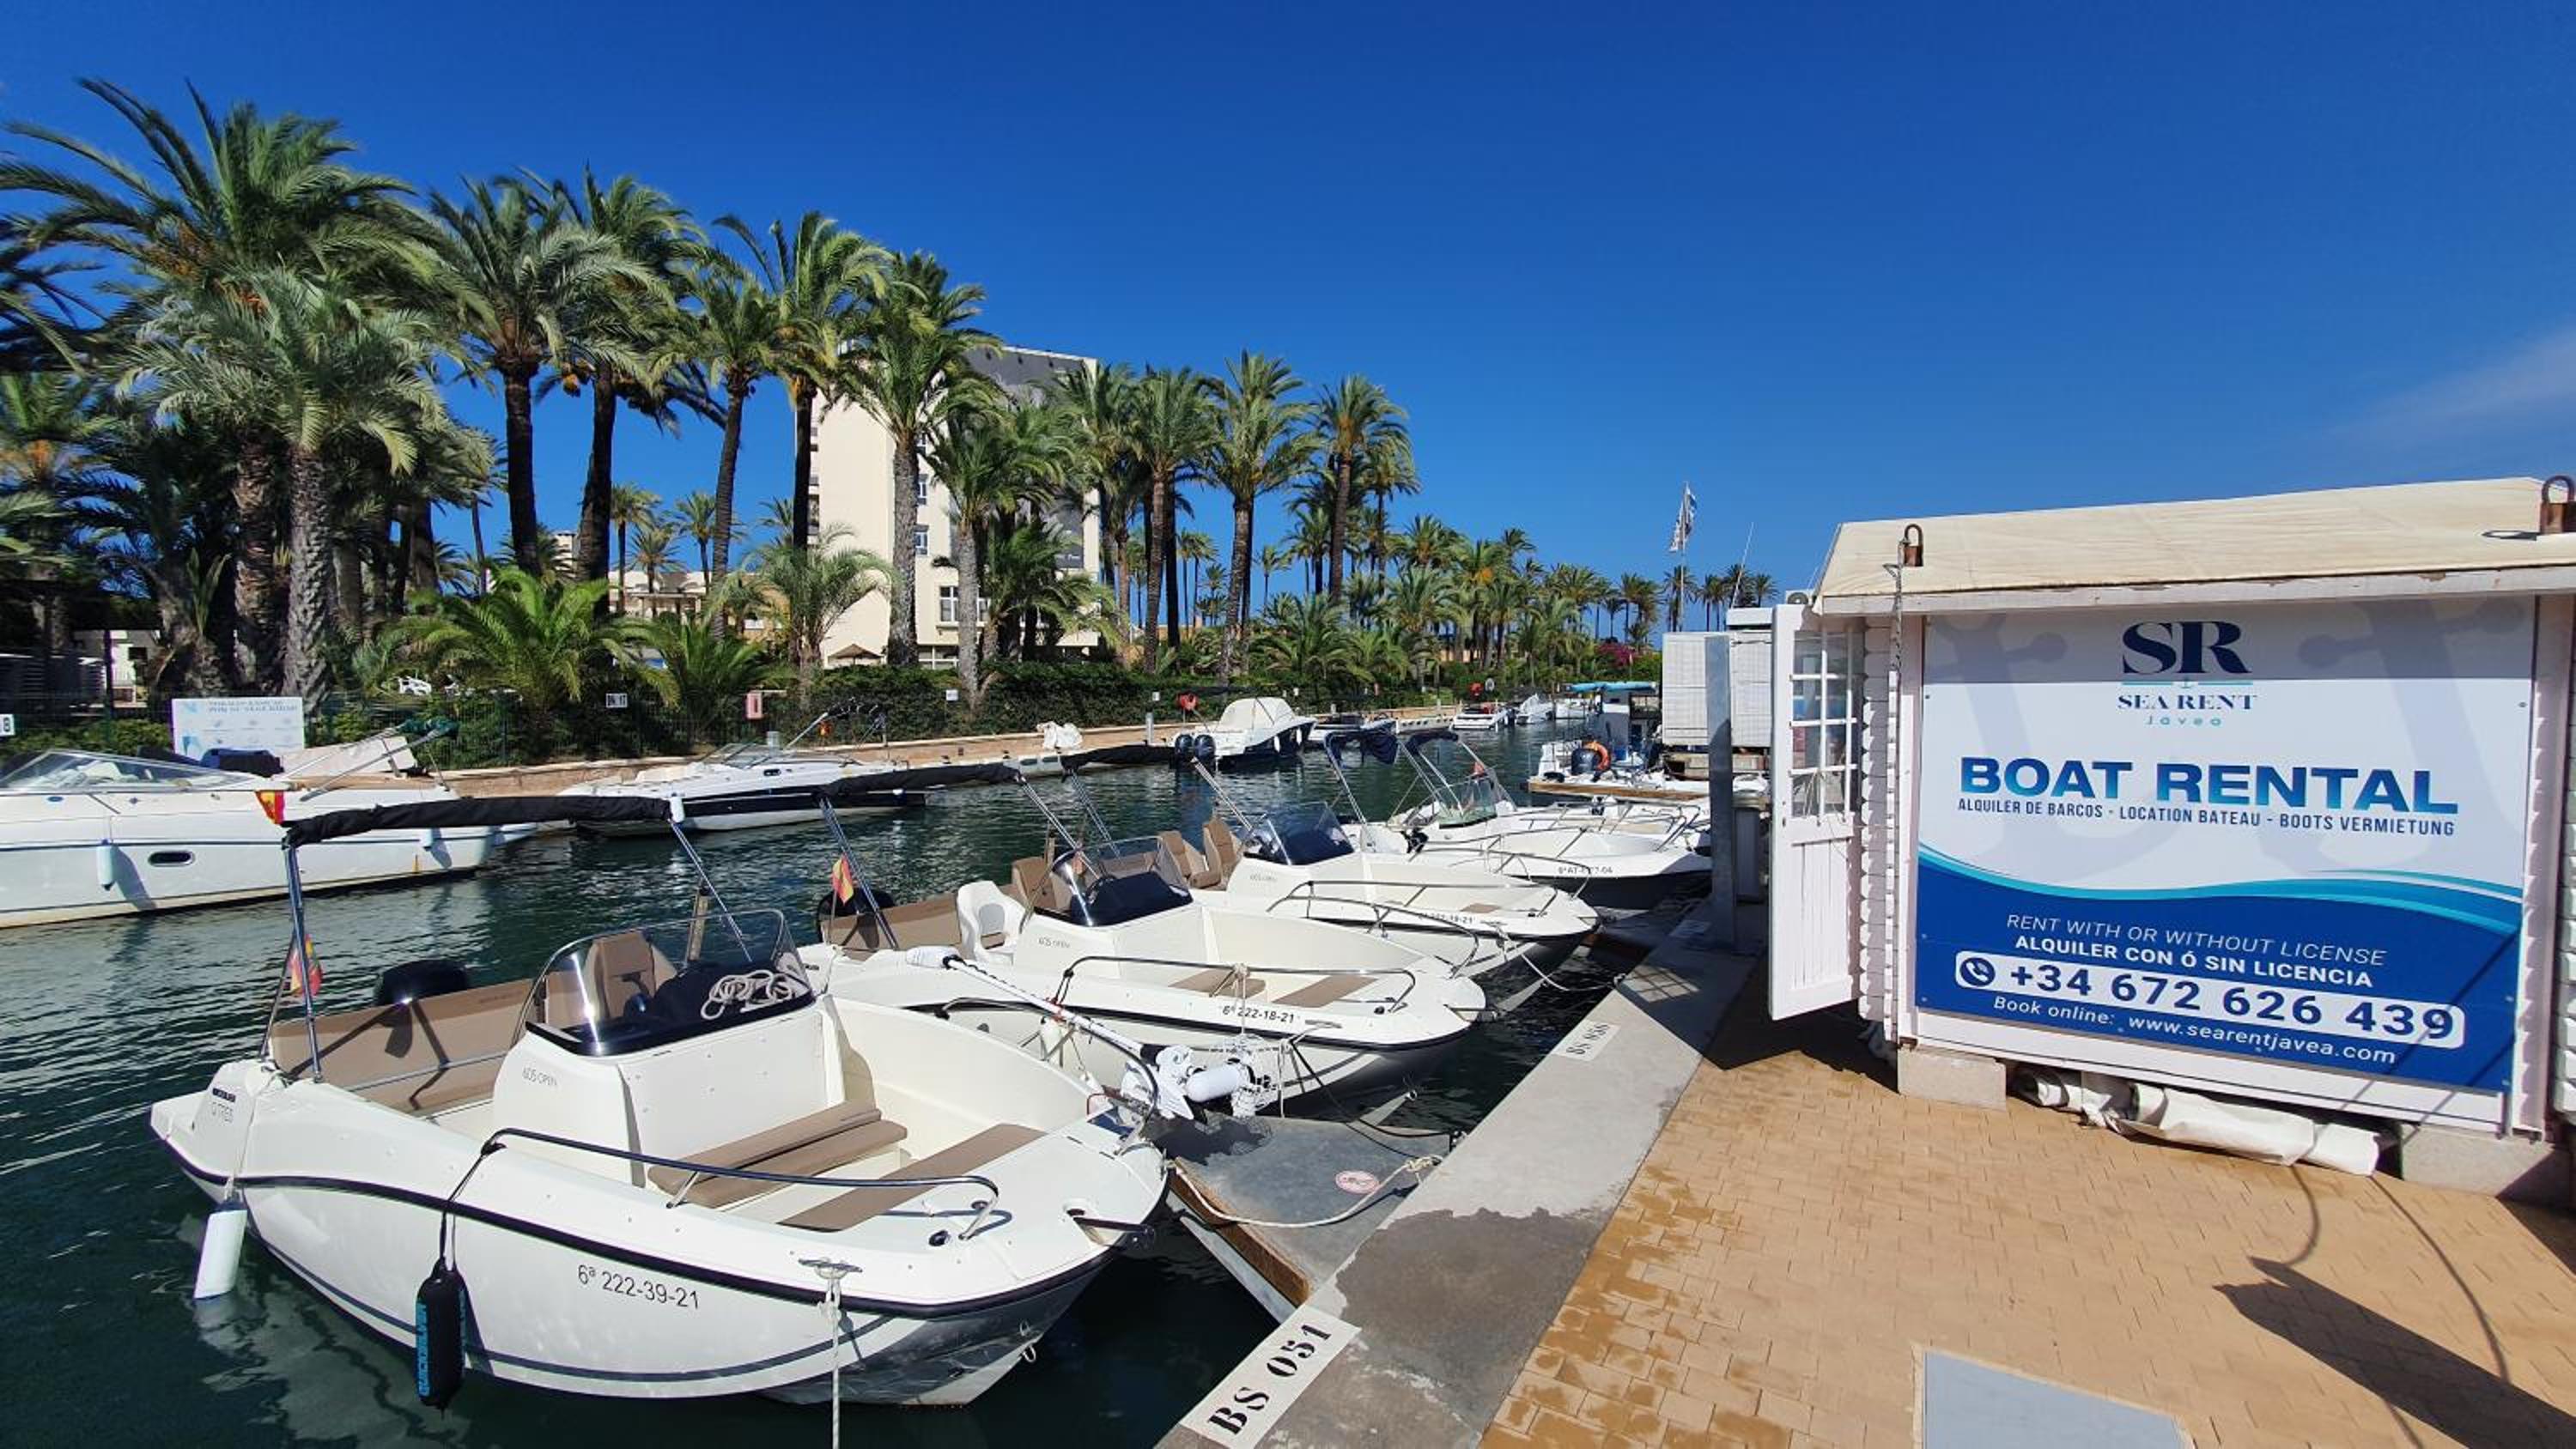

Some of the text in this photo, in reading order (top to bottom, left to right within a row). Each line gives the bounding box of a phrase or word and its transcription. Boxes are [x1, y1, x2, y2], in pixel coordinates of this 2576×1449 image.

[2123, 621, 2253, 675] SR
[2117, 694, 2257, 710] SEA RENT
[1960, 756, 2458, 815] BOAT RENTAL
[1958, 798, 2020, 814] ALQUILER
[2026, 801, 2043, 815] DE
[2048, 803, 2103, 818] BARCOS
[2119, 806, 2192, 822] LOCATION
[2198, 810, 2261, 827] BATEAU
[2280, 814, 2333, 830] BOOTS
[2340, 816, 2455, 836] VERMIETUNG
[2007, 914, 2388, 966] RENT WITH OR WITHOUT LICENSE
[2015, 936, 2373, 987] ALQUILER CON Ó SIN LICENCIA
[1237, 1007, 1294, 1024] 222-18-21
[2010, 965, 2454, 1040] +34 672 626 439
[1993, 996, 2396, 1064] Book online: www.searentjavea.com
[578, 1264, 699, 1310] 6ª 222-39-21
[1208, 1325, 1332, 1434] BS 051
